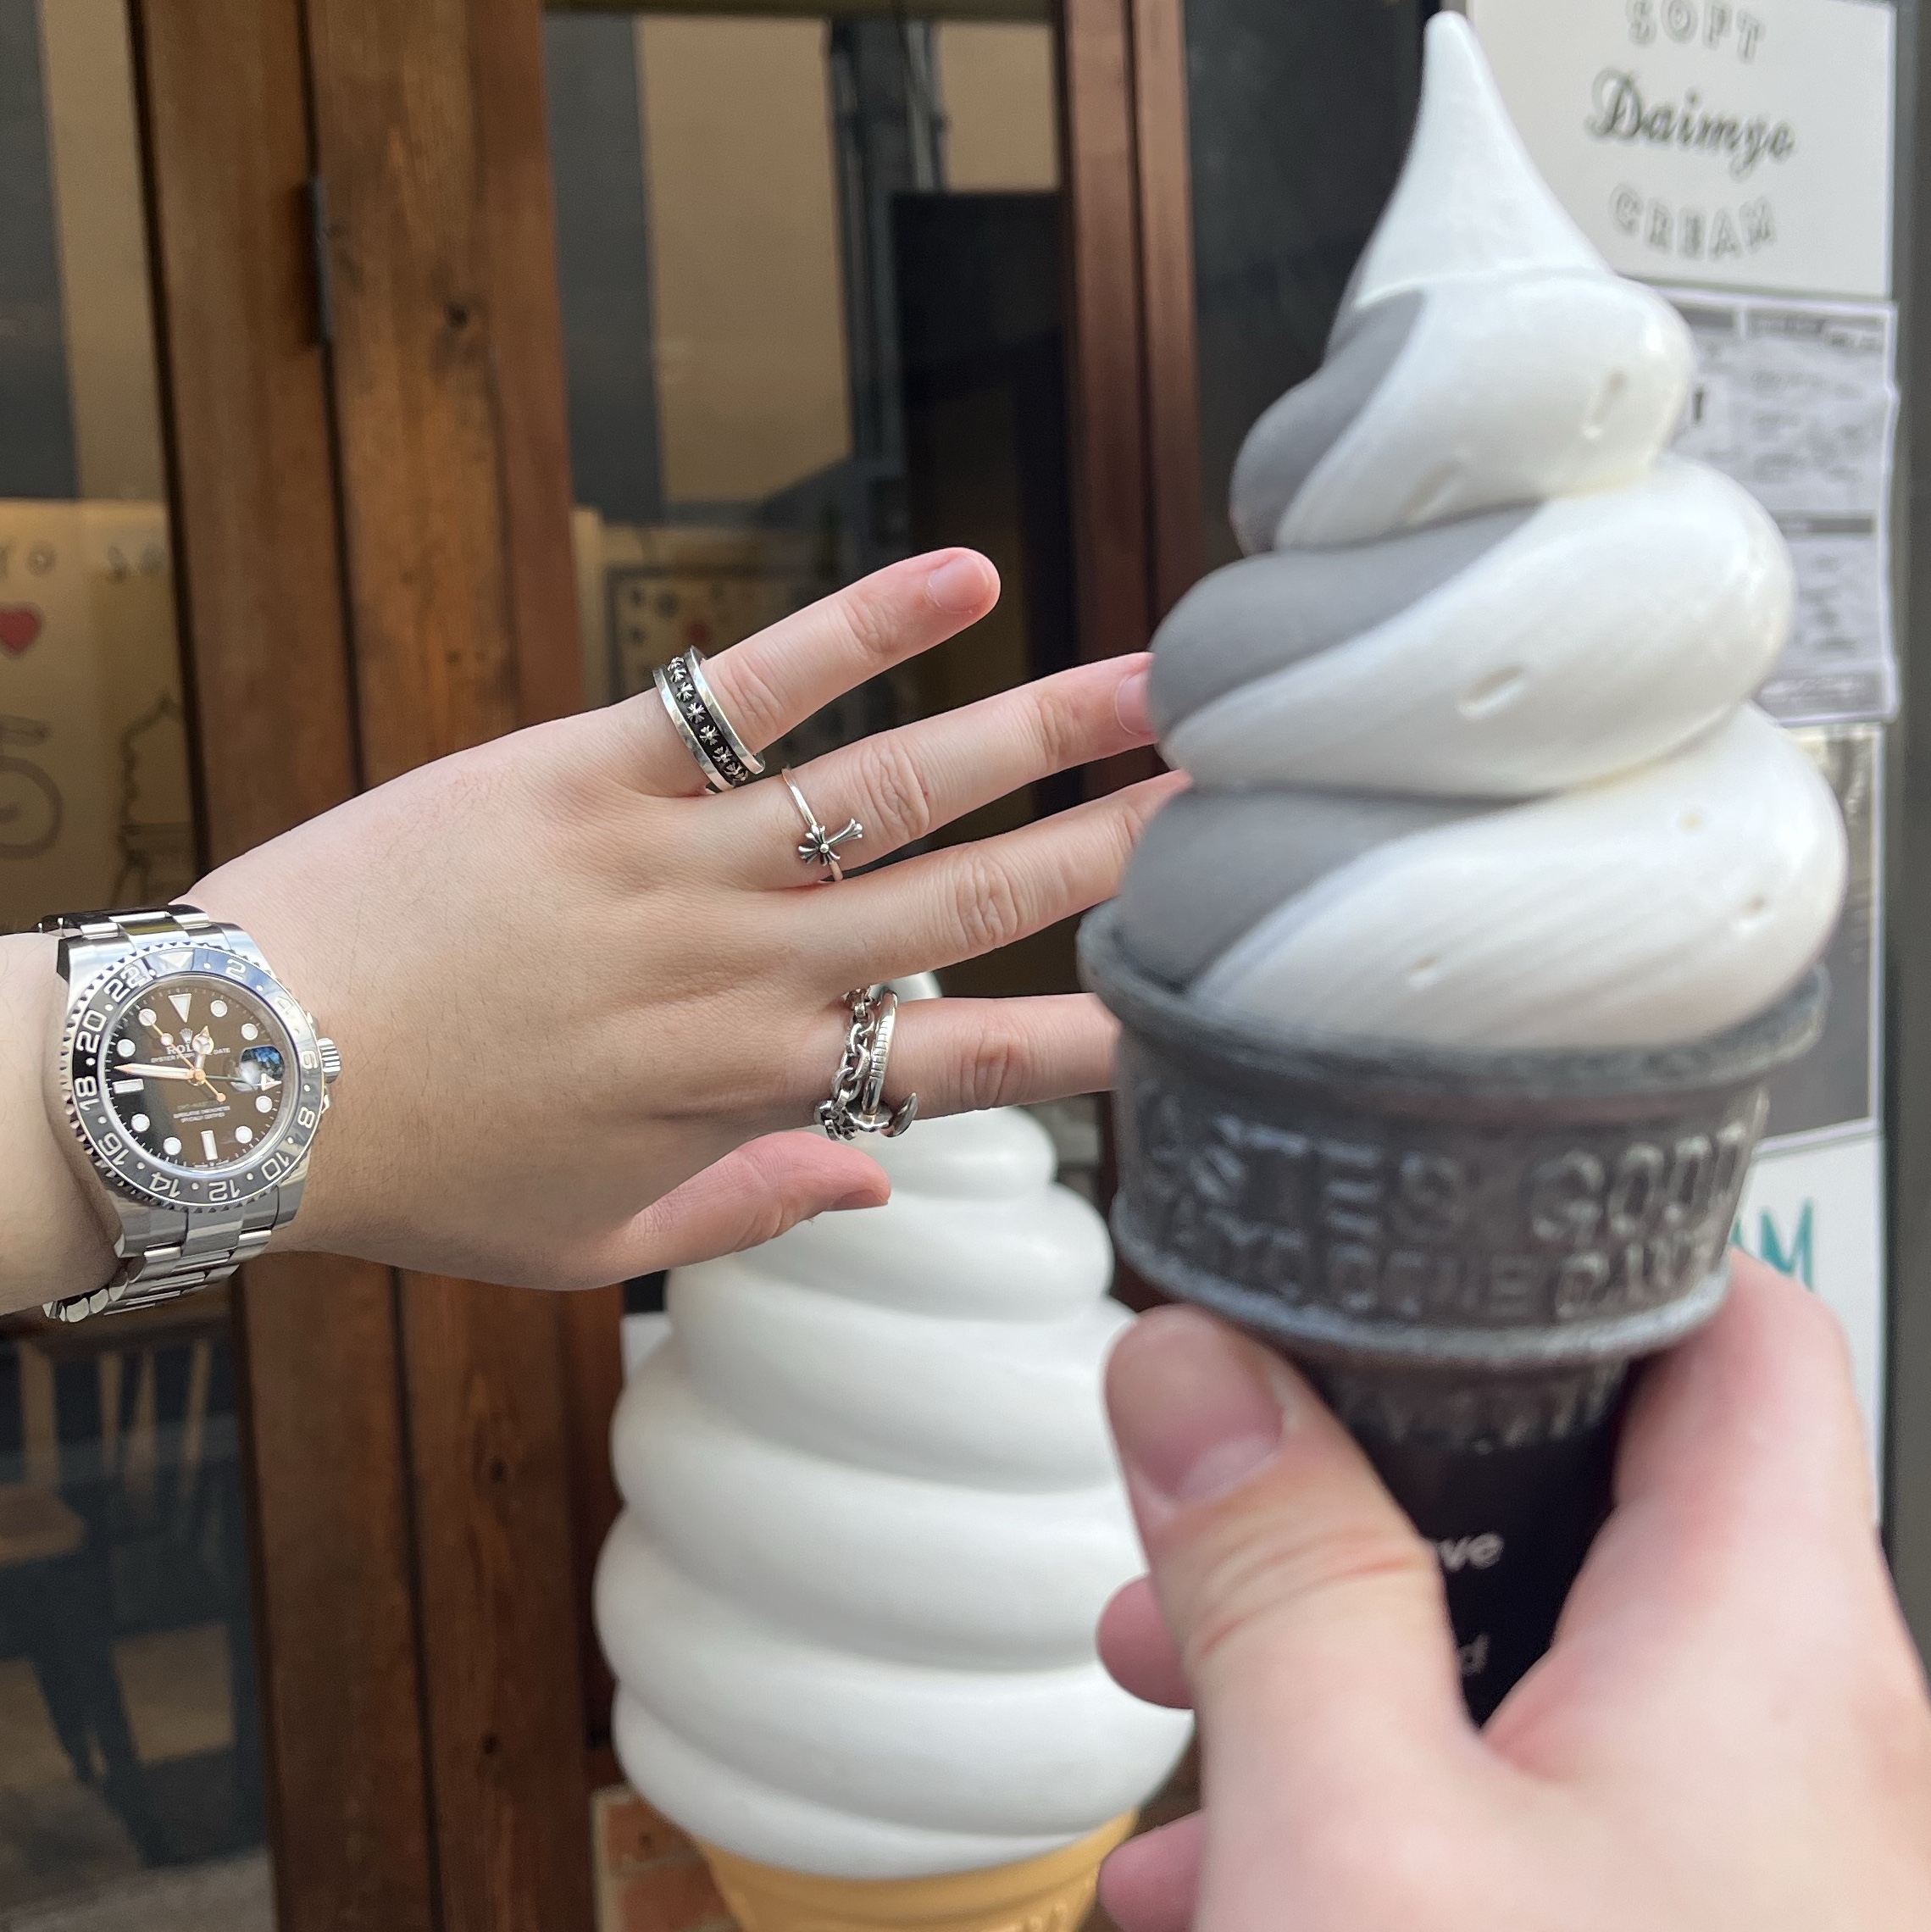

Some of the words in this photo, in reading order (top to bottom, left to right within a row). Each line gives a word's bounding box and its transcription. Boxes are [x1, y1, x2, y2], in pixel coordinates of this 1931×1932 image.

[1626, 0, 1766, 63] SOFT
[1585, 67, 1796, 181] Daimyo
[1611, 184, 1776, 261] CREAM
[103, 964, 148, 1003] 22
[225, 958, 247, 980] 2
[76, 1009, 108, 1053] 20
[300, 1050, 319, 1069] 6
[75, 1076, 100, 1111] 18
[297, 1107, 315, 1129] 8
[98, 1132, 130, 1165] 16
[261, 1152, 290, 1181] 10
[149, 1171, 180, 1198] 14
[208, 1179, 241, 1202] 12
